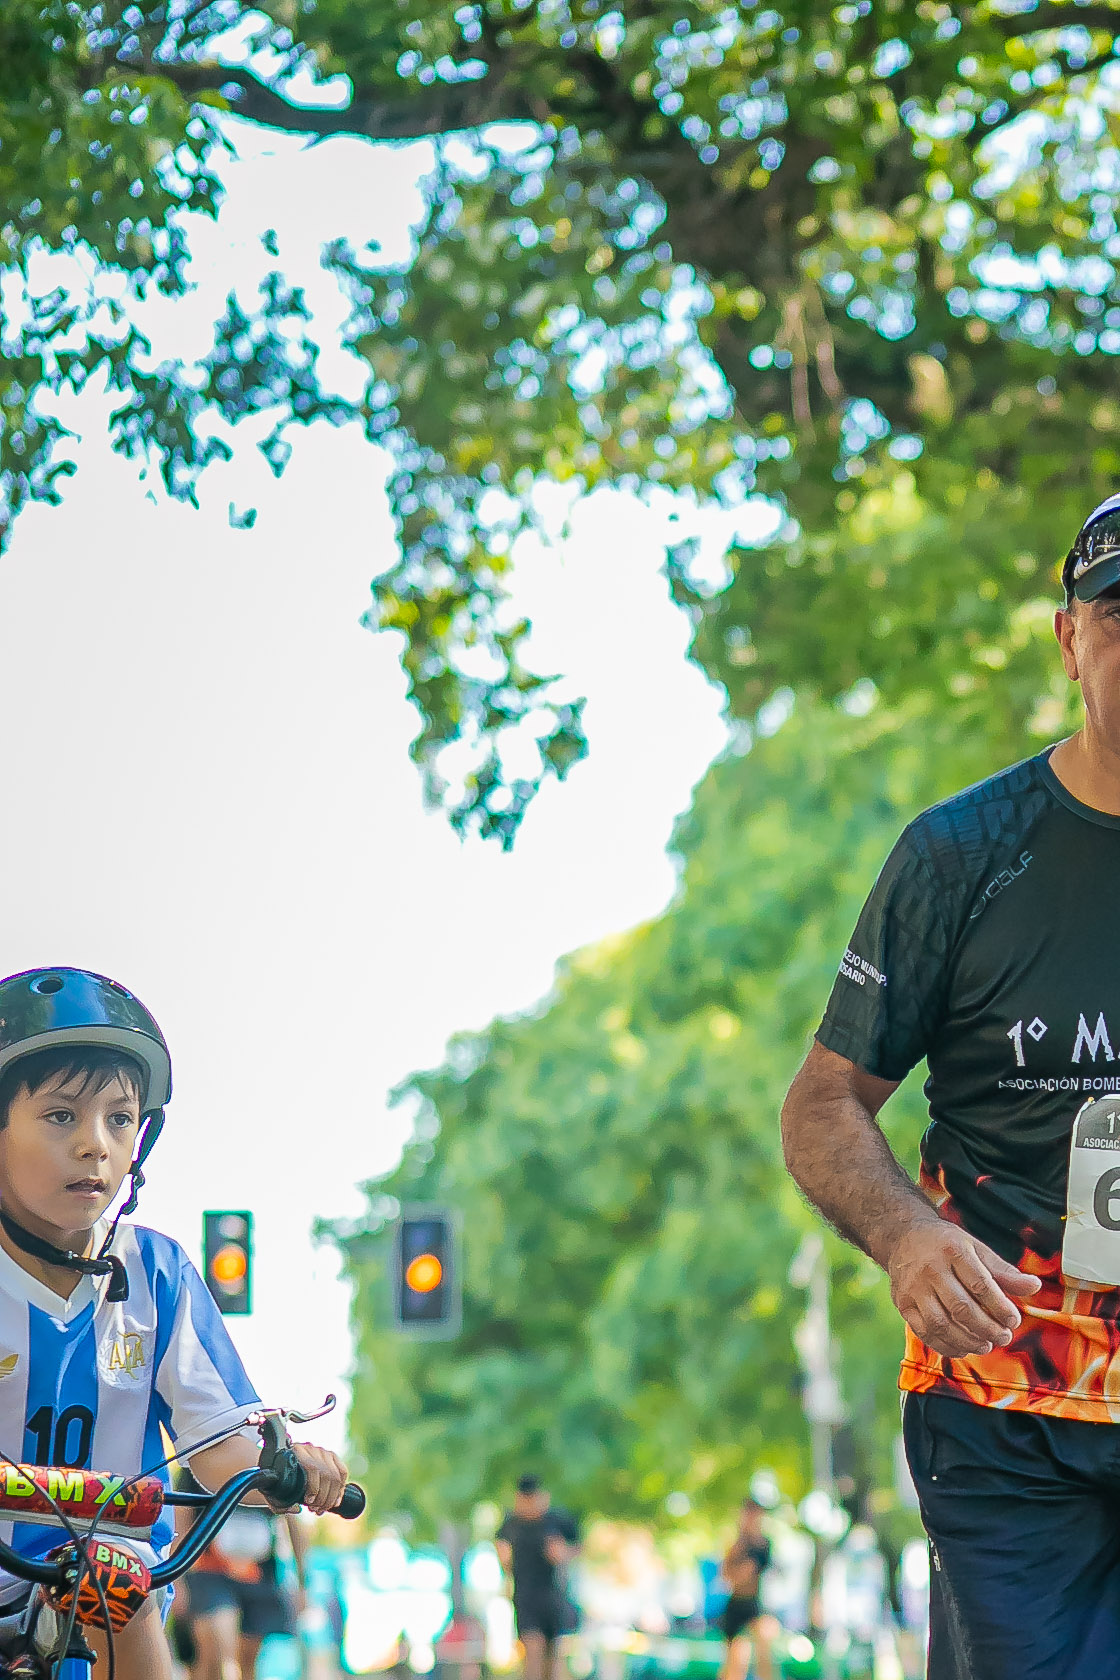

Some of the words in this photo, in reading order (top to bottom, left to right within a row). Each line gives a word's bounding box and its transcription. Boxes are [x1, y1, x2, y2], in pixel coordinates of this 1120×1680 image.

[26, 1404, 94, 1468] 10
[5, 1466, 127, 1506] BMX
[95, 1545, 143, 1577] BMX
